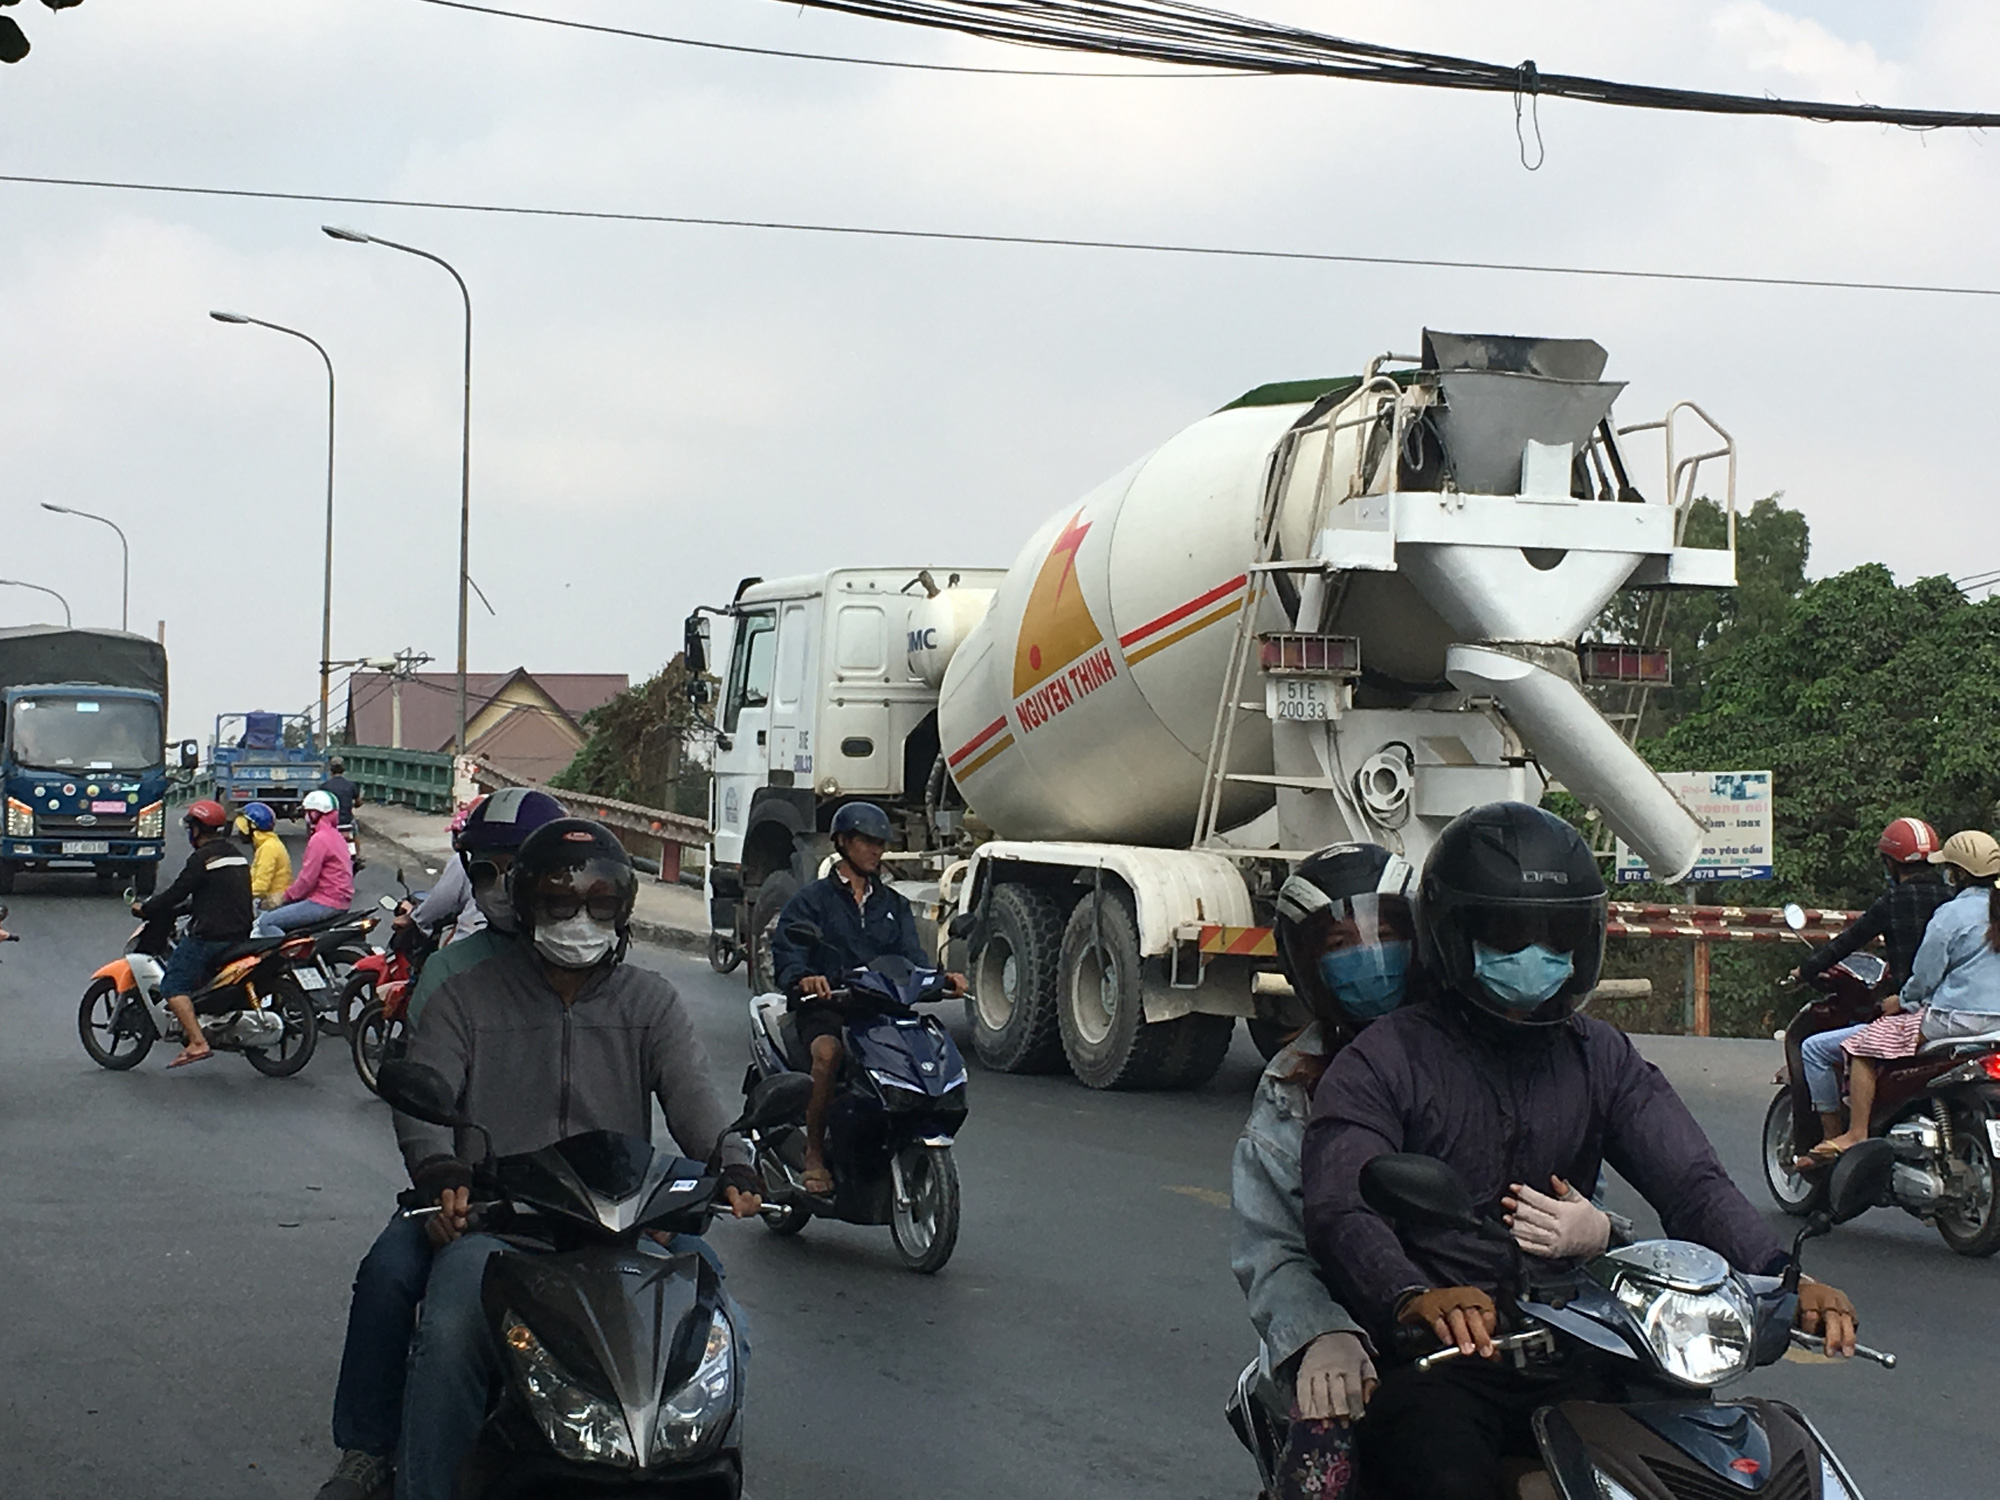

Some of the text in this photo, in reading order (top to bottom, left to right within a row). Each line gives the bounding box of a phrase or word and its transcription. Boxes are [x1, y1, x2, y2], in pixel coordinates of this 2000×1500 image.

[1015, 646, 1117, 734] NGUYEN THINH
[1287, 682, 1316, 700] 51E
[1278, 700, 1326, 719] 200.33
